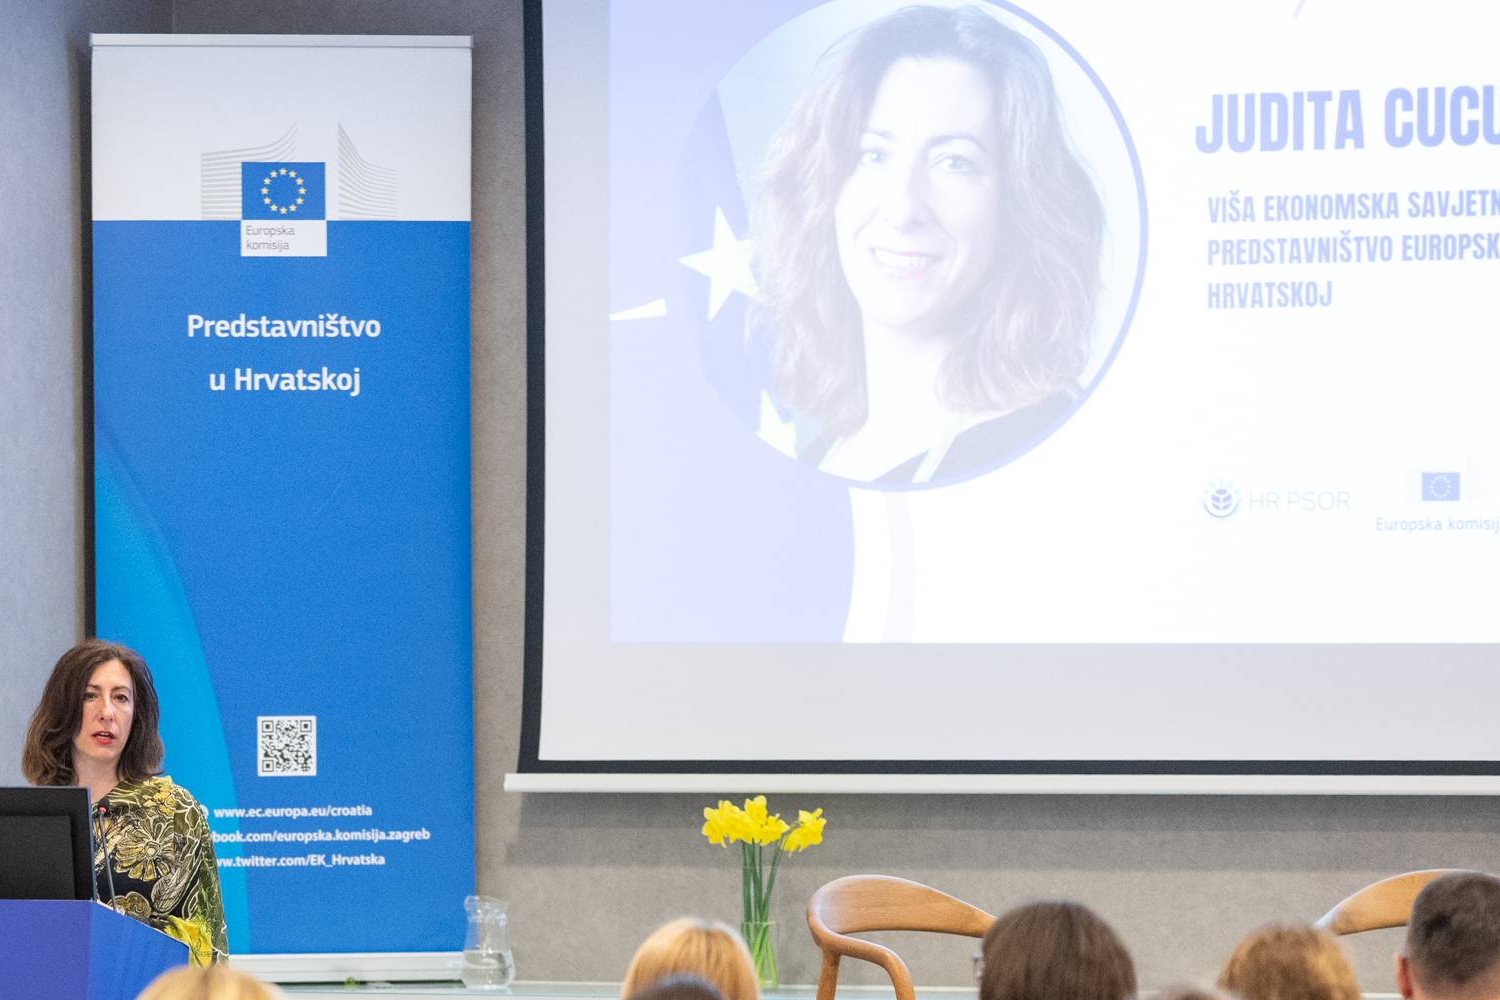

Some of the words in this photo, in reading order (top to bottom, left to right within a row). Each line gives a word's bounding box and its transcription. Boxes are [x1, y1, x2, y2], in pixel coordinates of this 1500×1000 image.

[1195, 89, 1365, 154] JUDITA
[1207, 190, 1256, 223] VIŠA
[1264, 192, 1399, 222] EKONOMSKA
[1407, 189, 1500, 218] SAVJETN
[245, 225, 295, 237] Europska
[246, 240, 290, 253] komisija
[1207, 229, 1393, 266] PREDSTAVNIŠTVO
[1402, 232, 1500, 261] EUROPSK
[1207, 281, 1333, 309] HRVATSKOJ
[187, 313, 381, 338] Predstavništvo
[209, 373, 226, 391] u
[234, 367, 361, 397] Hrvatskoj
[1248, 491, 1280, 511] HR
[1286, 491, 1351, 511] PSOR
[1375, 515, 1443, 534] Europska
[214, 805, 372, 819] www.ec.europa.eu/croatia
[211, 828, 431, 844] book.com/europska.komisija.zagreb
[216, 853, 386, 868] ww.twitter.com/EK_Hrvatska
